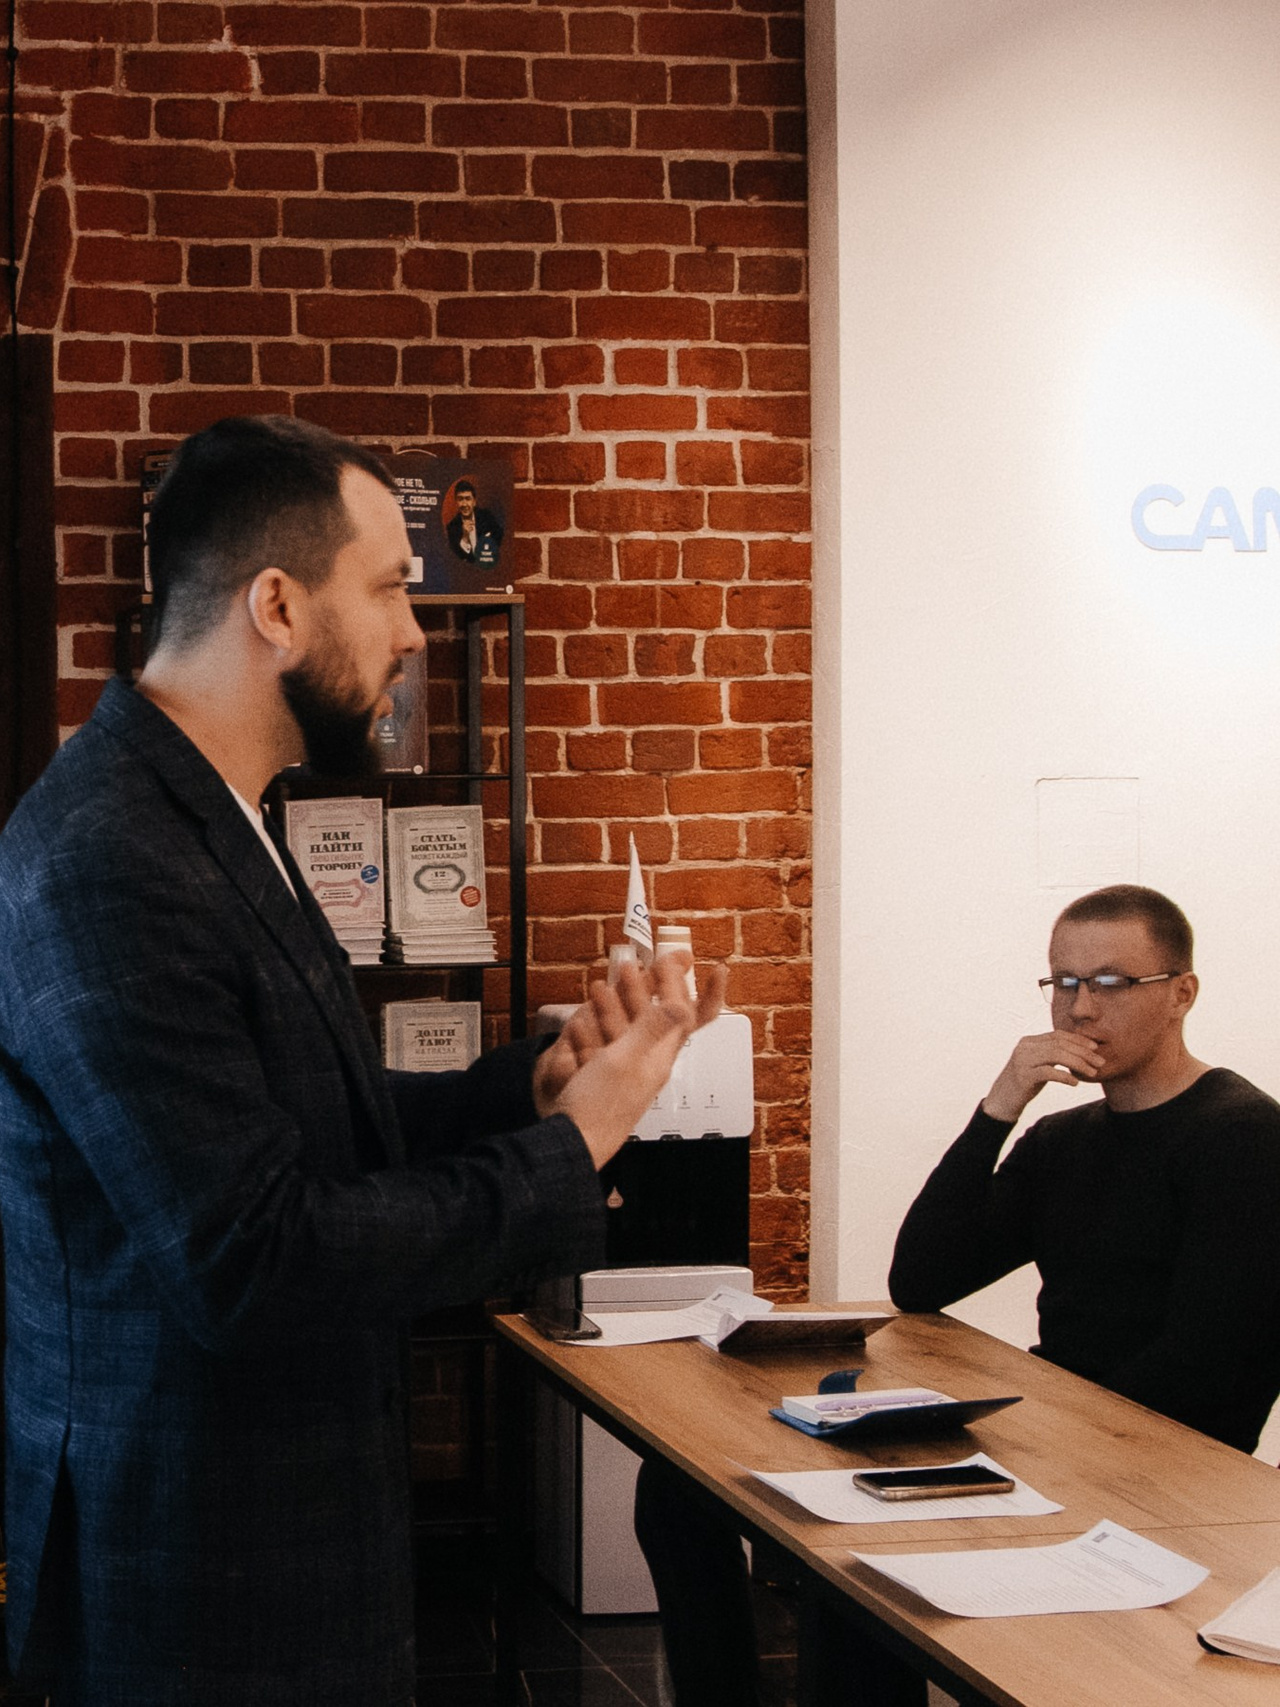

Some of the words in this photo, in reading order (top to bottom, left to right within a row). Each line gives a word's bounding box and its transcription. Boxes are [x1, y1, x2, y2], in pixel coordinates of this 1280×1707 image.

[321, 831, 351, 842] КАК
[420, 834, 457, 843] СТАТЬ
[310, 842, 364, 854] НАЙТИ
[411, 842, 467, 853] БОГАТЫМ
[411, 853, 435, 861] МОЖЕТ
[436, 851, 469, 861] КАЖДЫЙ
[310, 862, 364, 873] СТОРОНУ
[433, 870, 447, 878] 12
[415, 1029, 456, 1039] ДОЛГИ
[417, 1038, 453, 1047] ТАЮТ
